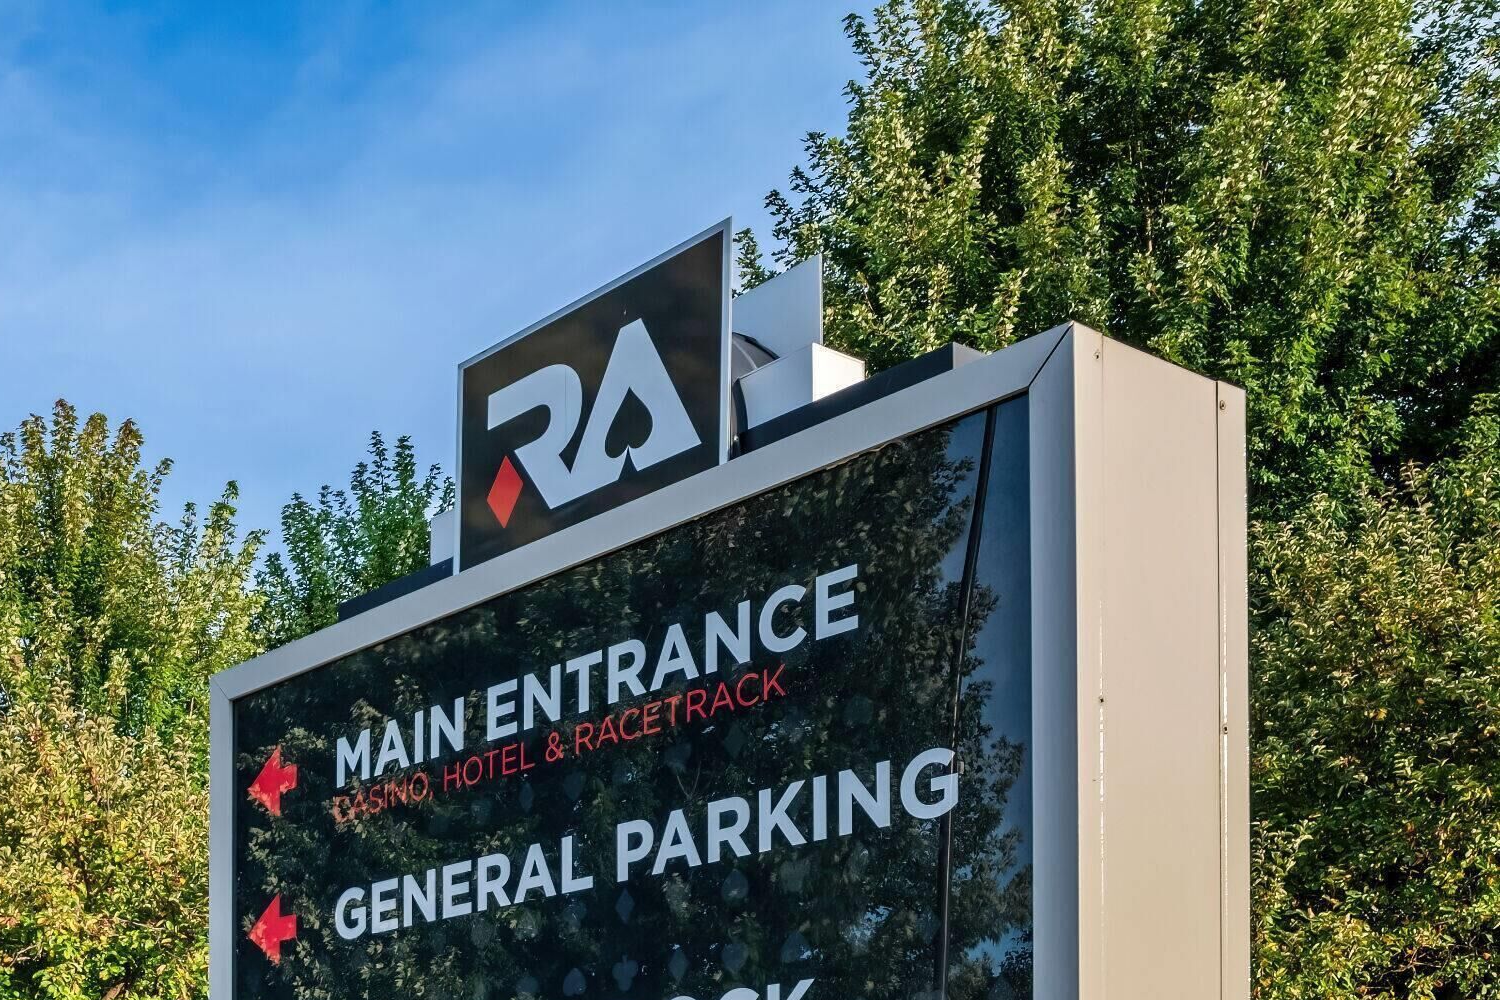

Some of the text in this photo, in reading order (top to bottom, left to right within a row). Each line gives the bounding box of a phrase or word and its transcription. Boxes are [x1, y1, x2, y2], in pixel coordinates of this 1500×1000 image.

[487, 317, 702, 510] RA
[336, 564, 858, 789] MAIN ENTRANCE
[444, 742, 536, 793] HOTEL
[545, 731, 564, 763] &
[575, 663, 786, 754] RACETRACK
[334, 747, 959, 940] GENERAL PARKING
